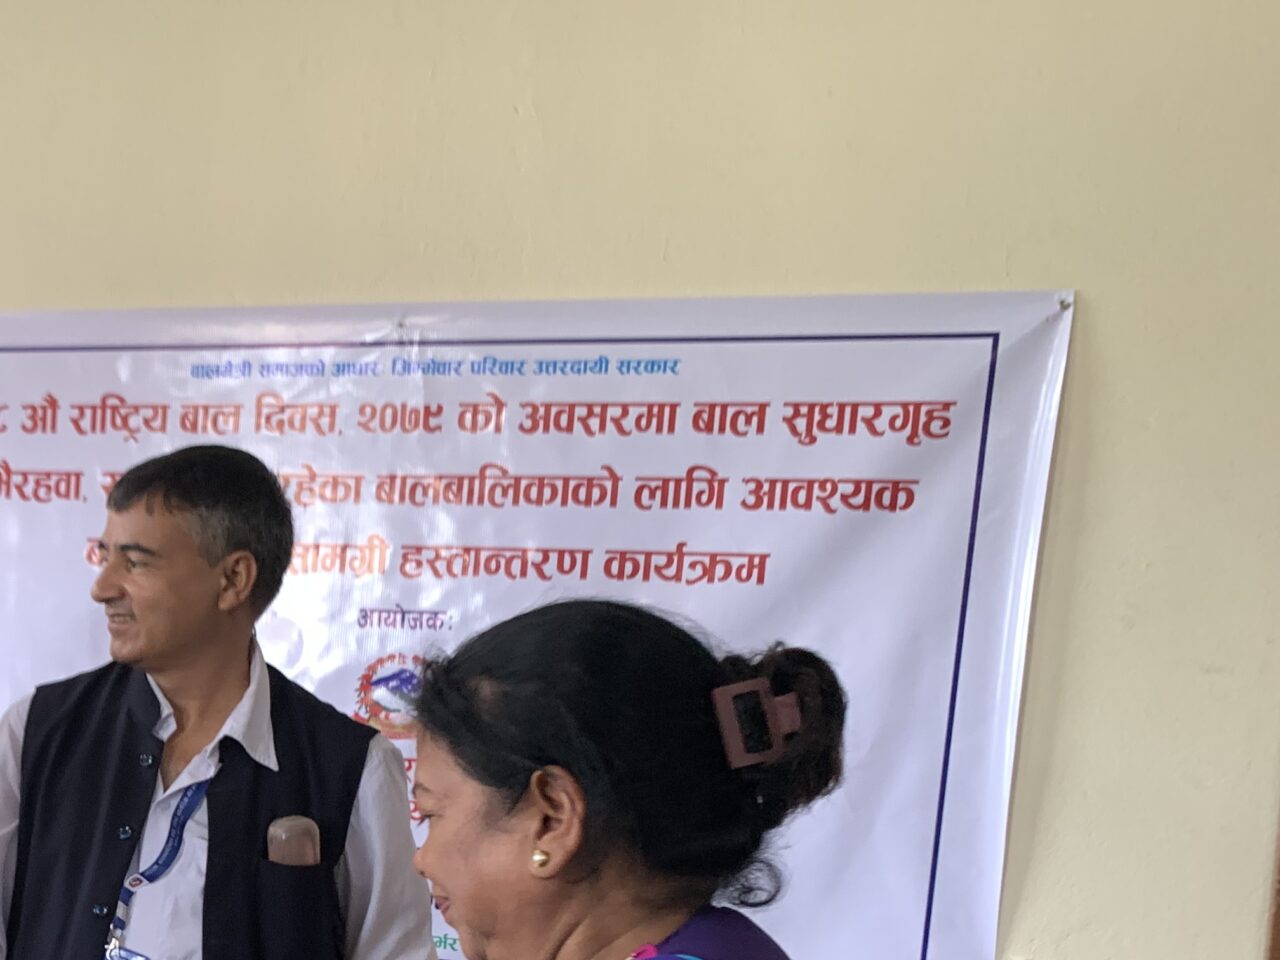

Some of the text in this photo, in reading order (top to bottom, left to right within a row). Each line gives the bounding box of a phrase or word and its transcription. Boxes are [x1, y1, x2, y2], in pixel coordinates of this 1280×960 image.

[470, 356, 526, 376] परिवार
[532, 355, 610, 376] उत्तरदायी
[616, 357, 682, 376] सरकार
[69, 393, 169, 443] राष्ट्रिय
[179, 403, 244, 435] बाल
[356, 401, 443, 436] २०७९
[457, 391, 507, 435] को
[518, 401, 681, 436] अवसरमा
[692, 402, 768, 436] बाल
[780, 401, 957, 446] सुधारगृह
[374, 462, 621, 509] बालबालिकाको
[633, 464, 729, 511] लागि
[740, 477, 920, 515] आवश्यक
[399, 544, 592, 582] हस्तान्तरण
[602, 541, 770, 586] कार्यक्रम
